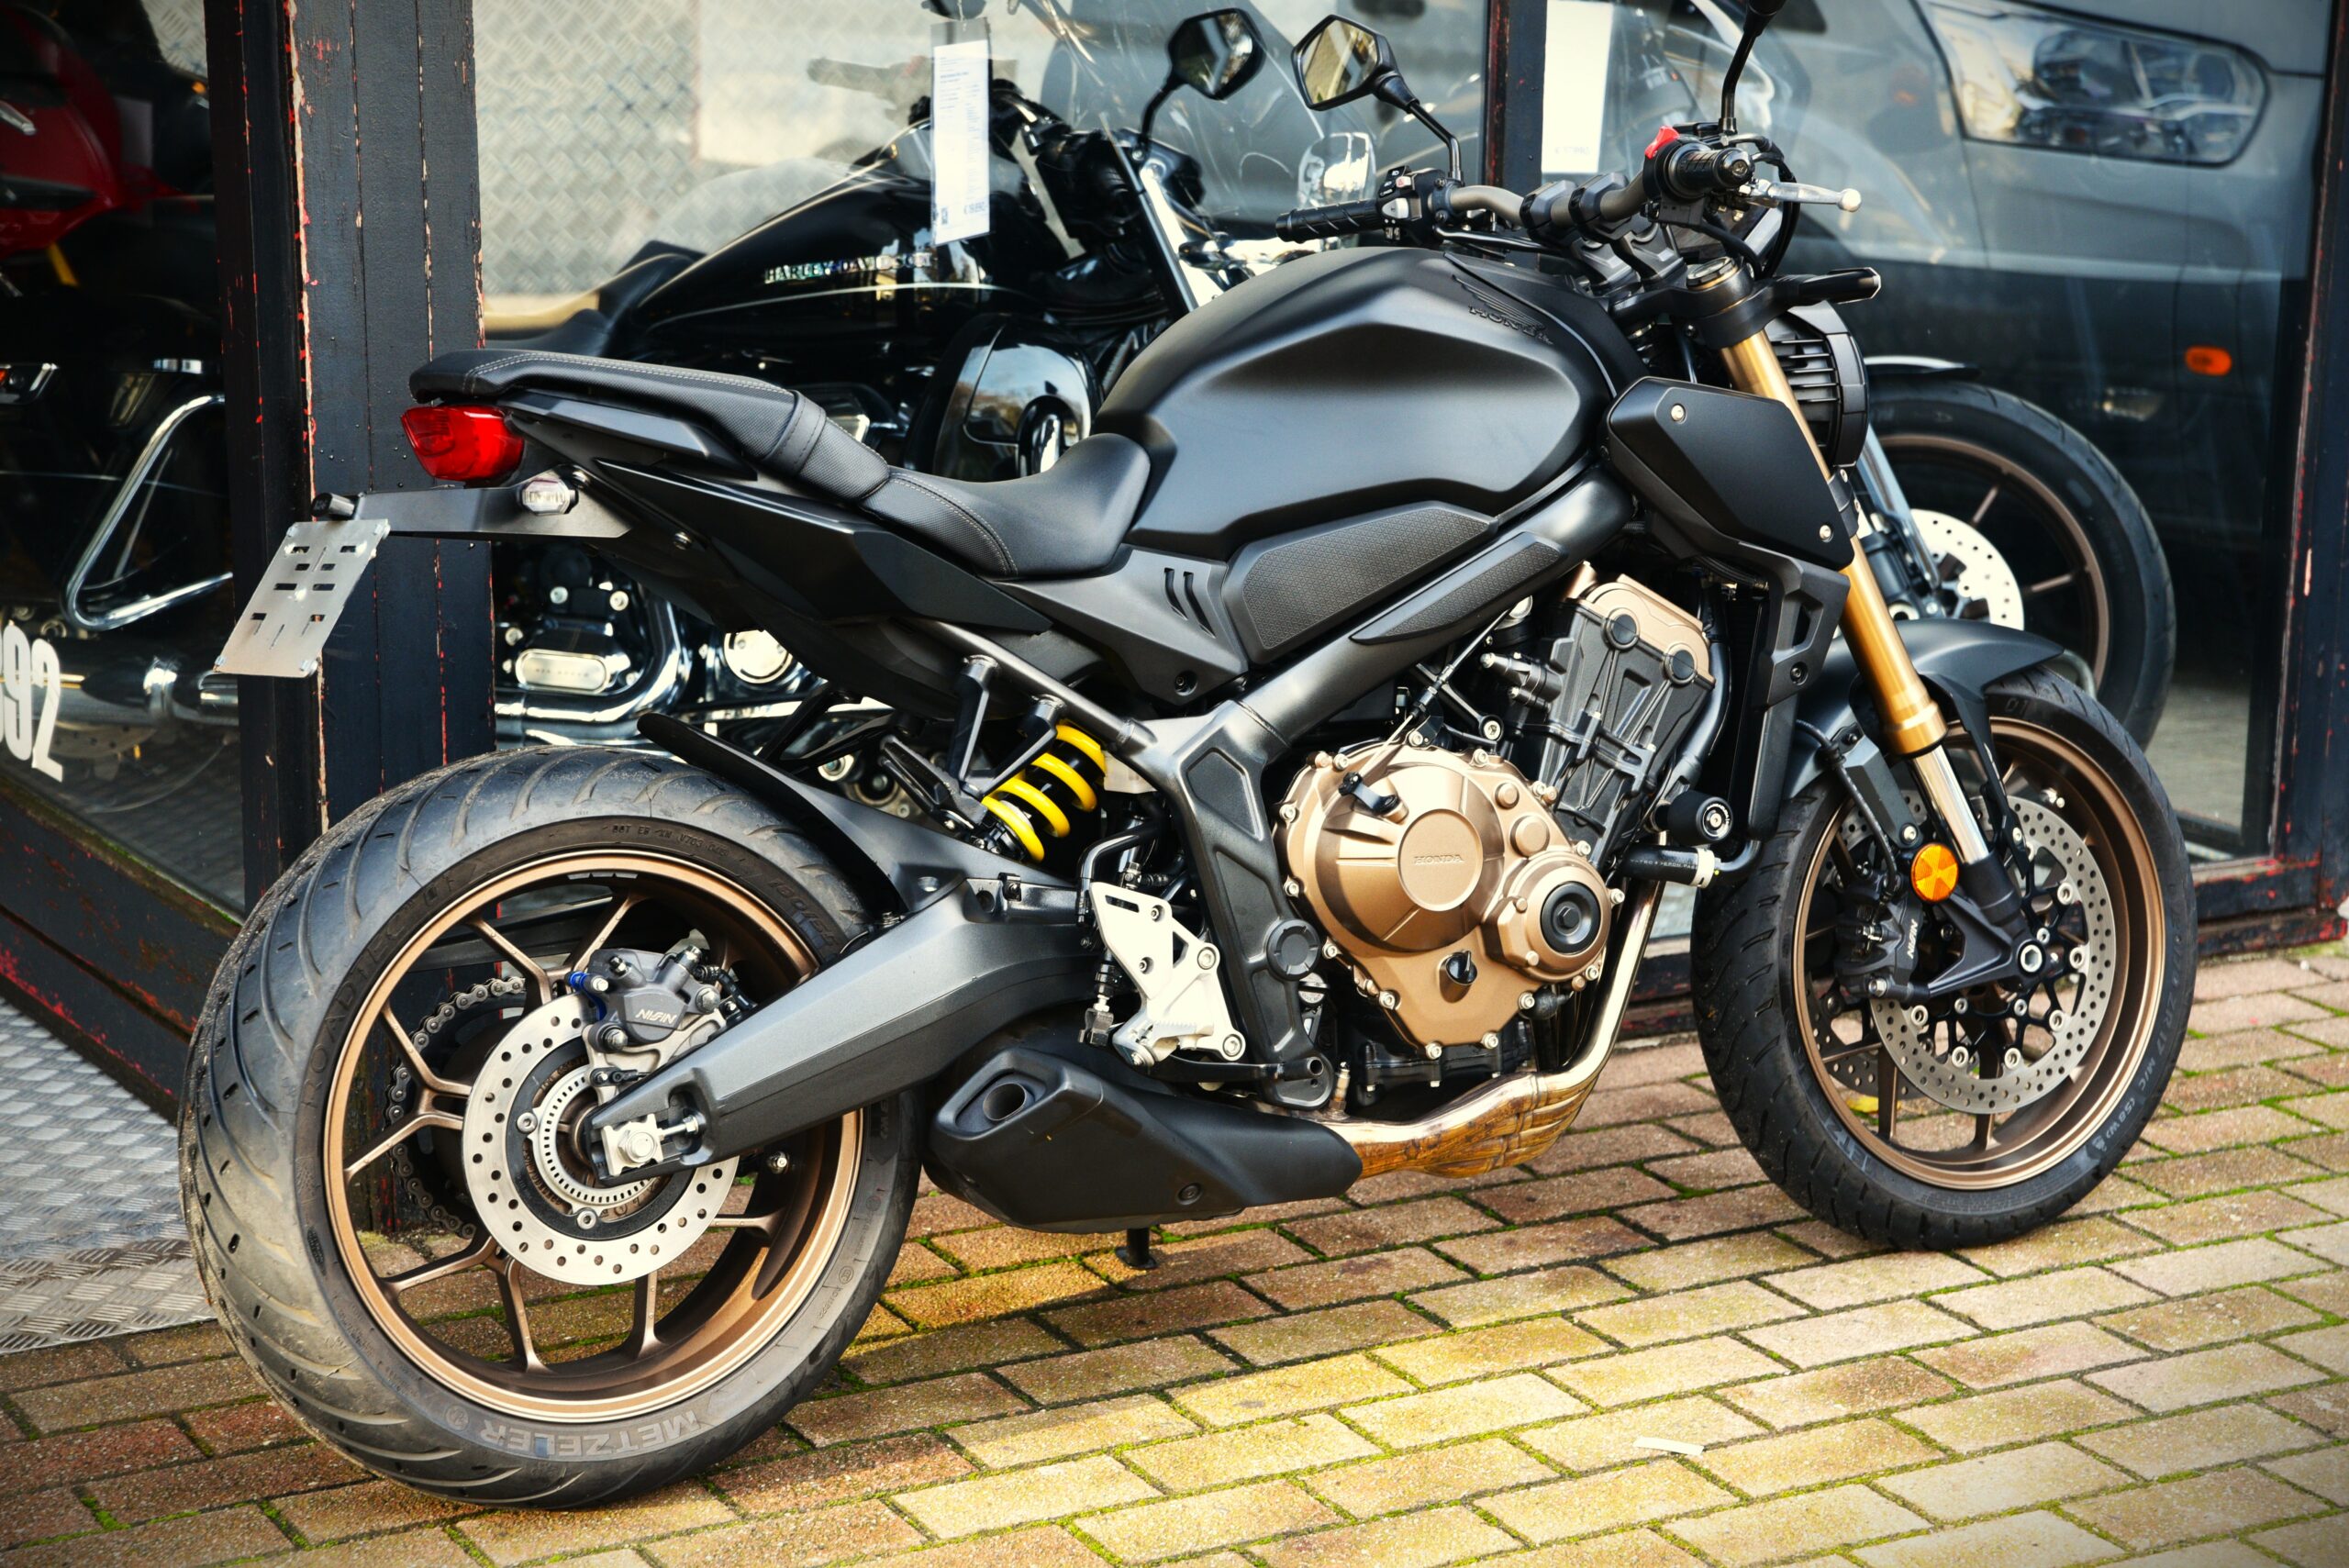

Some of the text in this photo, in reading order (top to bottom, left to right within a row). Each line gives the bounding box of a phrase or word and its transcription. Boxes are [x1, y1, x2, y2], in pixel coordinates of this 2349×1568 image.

[1468, 304, 1554, 346] HONDA
[0, 619, 63, 783] 92
[1414, 853, 1464, 867] HONDA
[479, 1409, 703, 1457] METZELER
